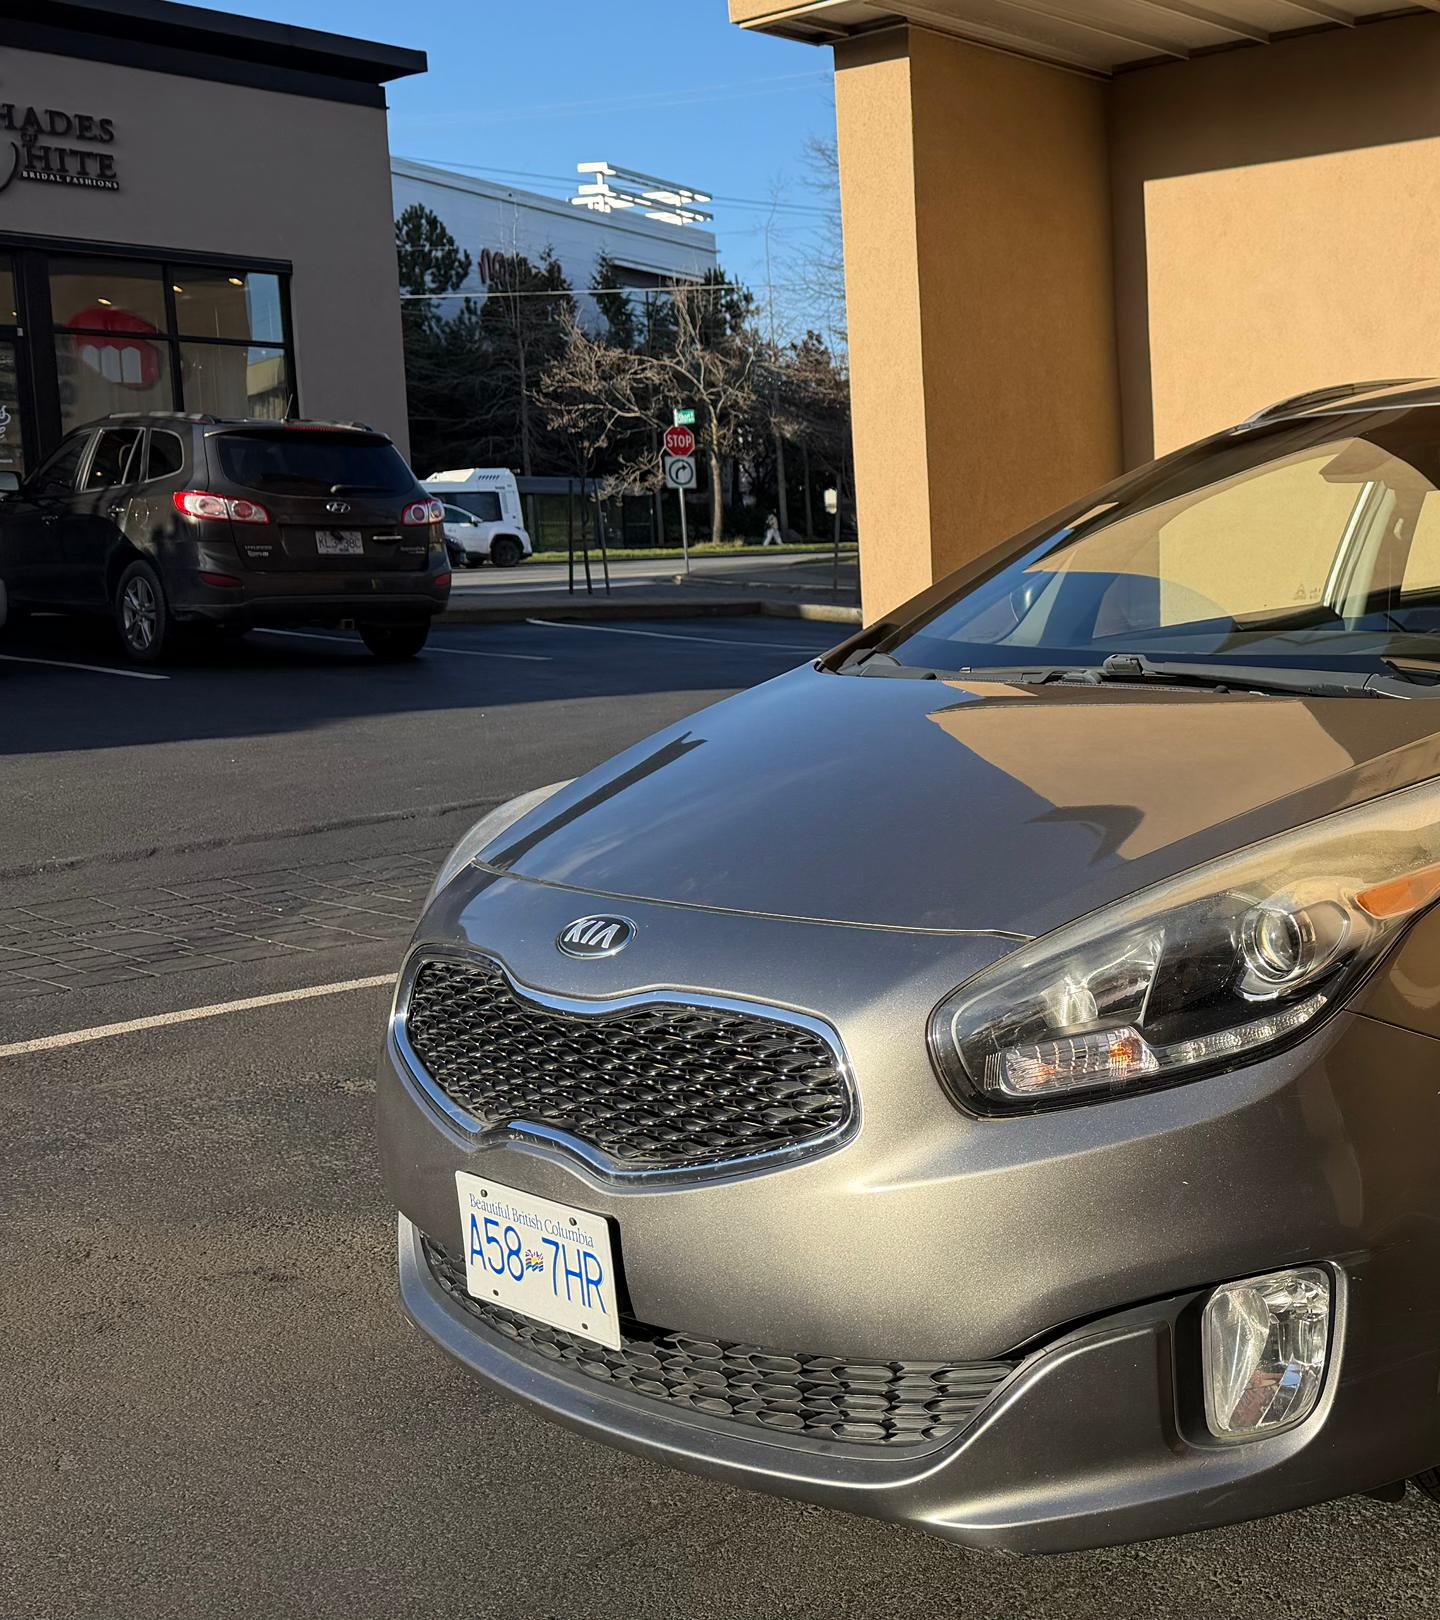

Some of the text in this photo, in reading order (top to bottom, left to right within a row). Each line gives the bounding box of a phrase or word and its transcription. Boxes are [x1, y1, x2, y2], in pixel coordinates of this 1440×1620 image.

[0, 142, 117, 186] HITE
[22, 170, 119, 190] BRIDAL FASHIONS
[666, 434, 692, 448] STOP
[564, 919, 620, 949] KIA
[468, 1193, 594, 1249] Beautiful British Columbia
[470, 1212, 607, 1314] A58 7HR
